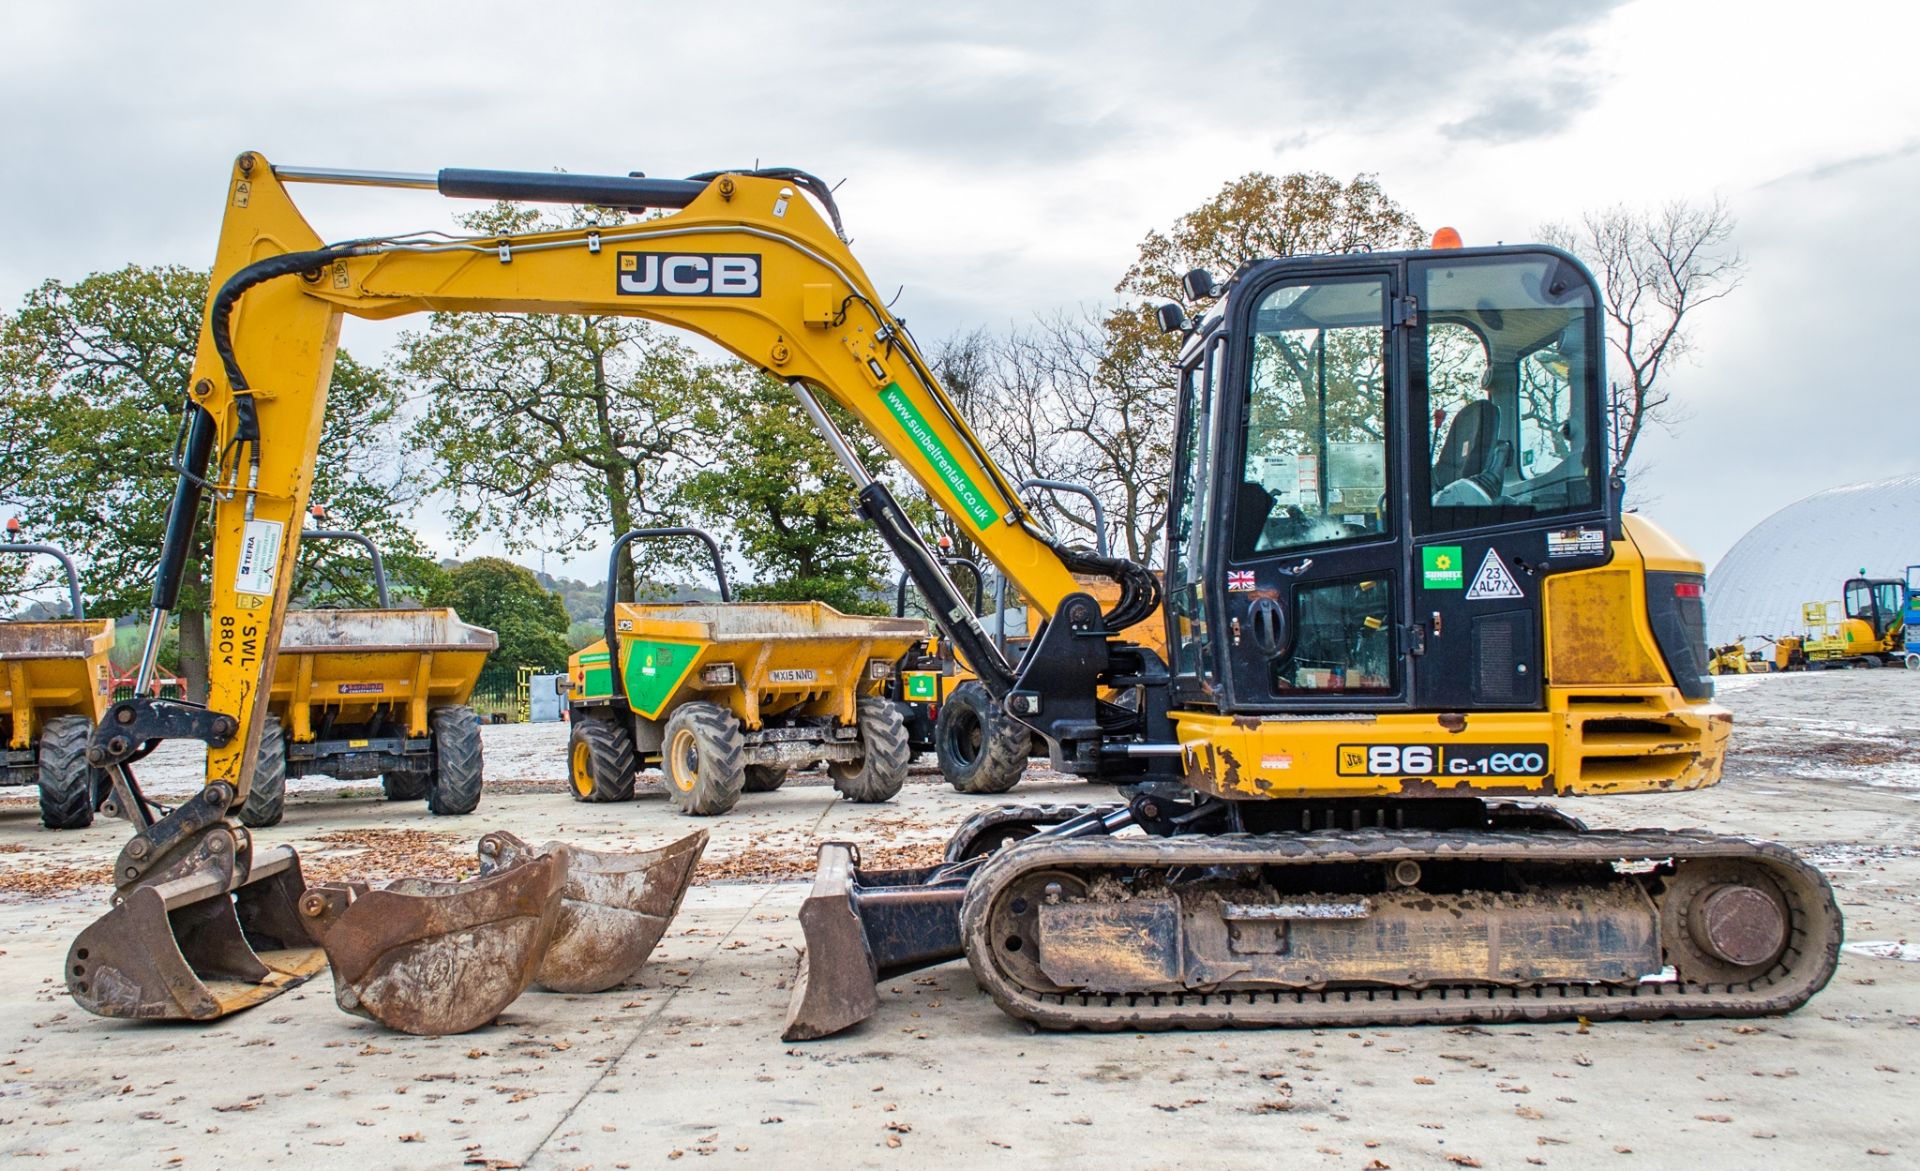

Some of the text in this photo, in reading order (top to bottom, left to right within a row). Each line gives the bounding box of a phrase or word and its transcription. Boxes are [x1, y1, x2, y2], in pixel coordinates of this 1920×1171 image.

[621, 256, 758, 294] JCB
[887, 392, 989, 521] www.sunbeltrentals.co.uk
[244, 537, 256, 565] TEFRA
[1486, 568, 1501, 579] 23
[1479, 580, 1509, 592] AL7X
[617, 620, 633, 631] JCB
[773, 671, 794, 682] MX15
[1347, 753, 1363, 767] JCB
[1368, 745, 1432, 774] 86
